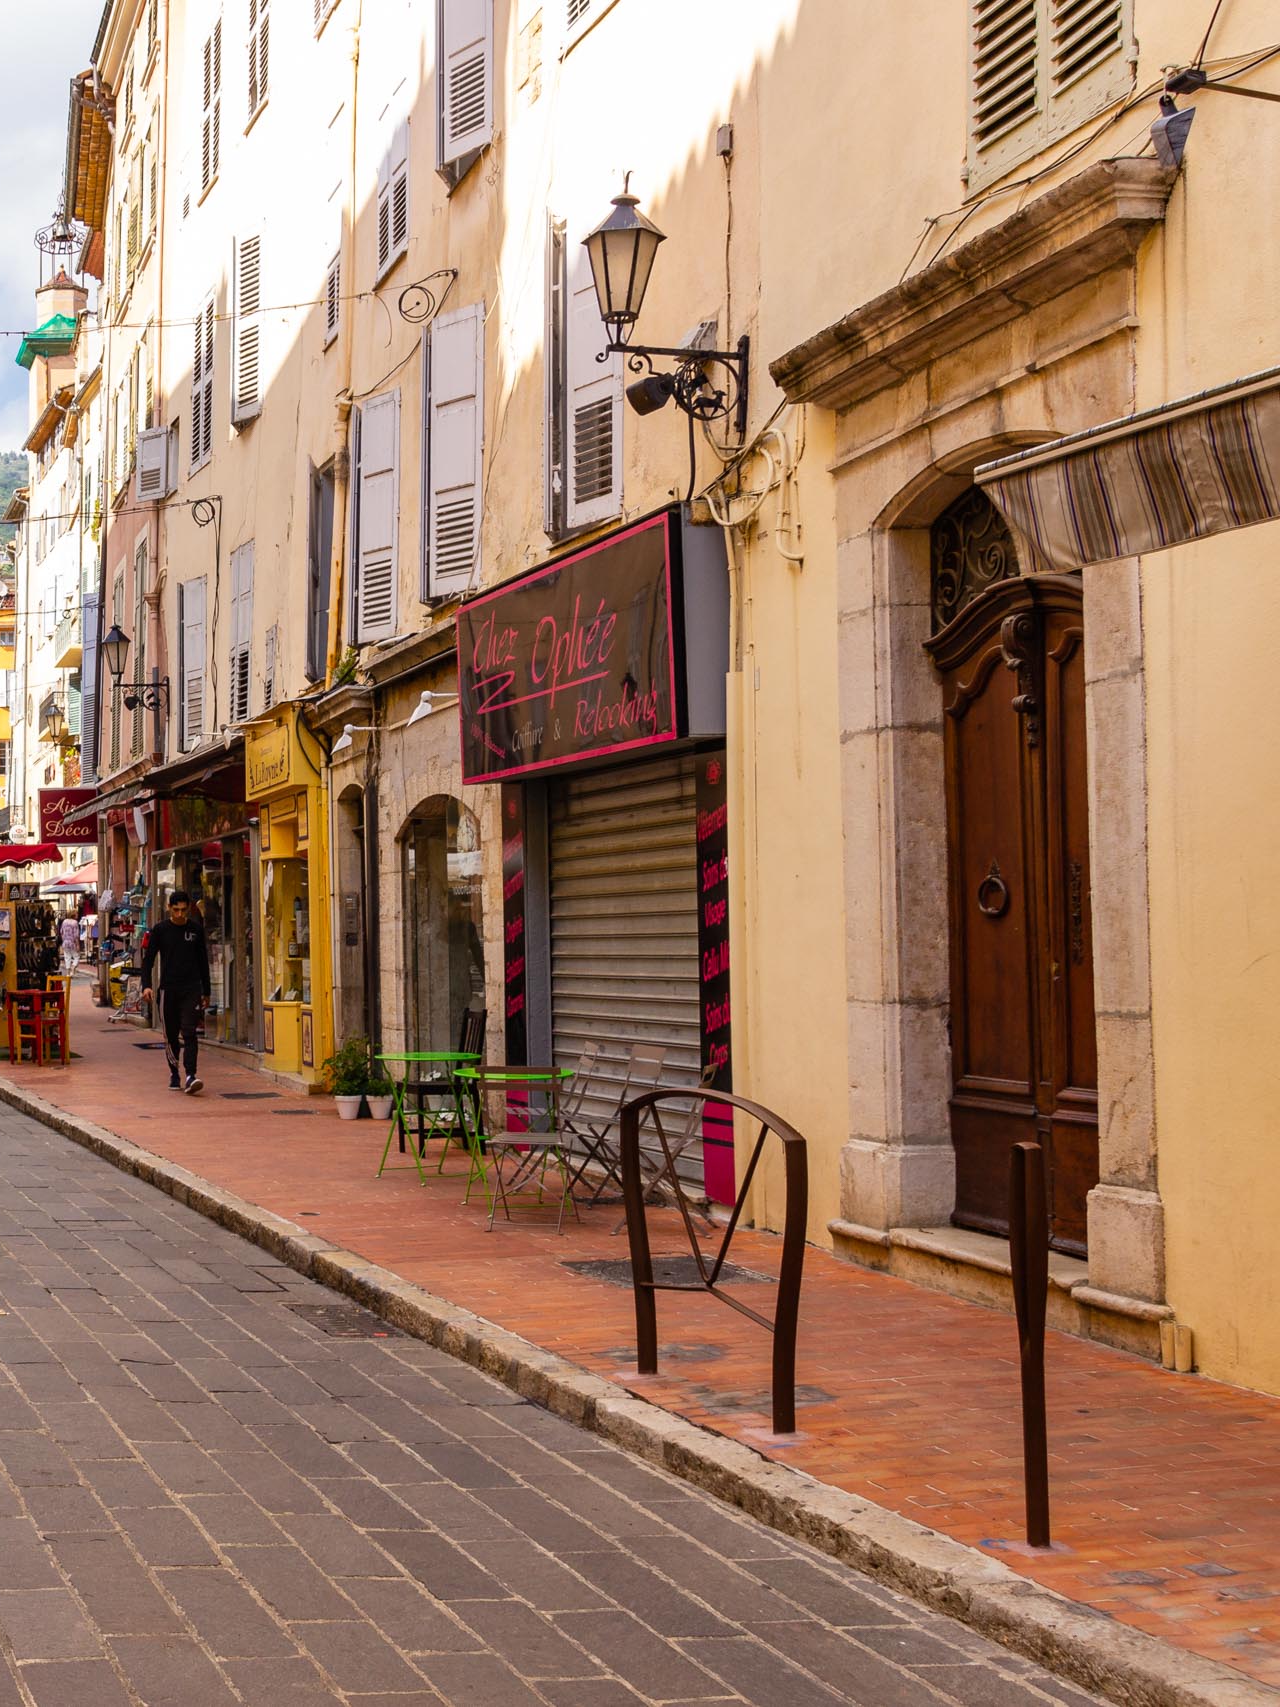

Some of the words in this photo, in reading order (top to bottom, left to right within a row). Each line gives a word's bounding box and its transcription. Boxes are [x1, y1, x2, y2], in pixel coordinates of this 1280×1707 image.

[473, 609, 519, 673] Chez
[553, 717, 561, 741] &
[573, 677, 657, 738] Relooking
[45, 819, 92, 837] Déco
